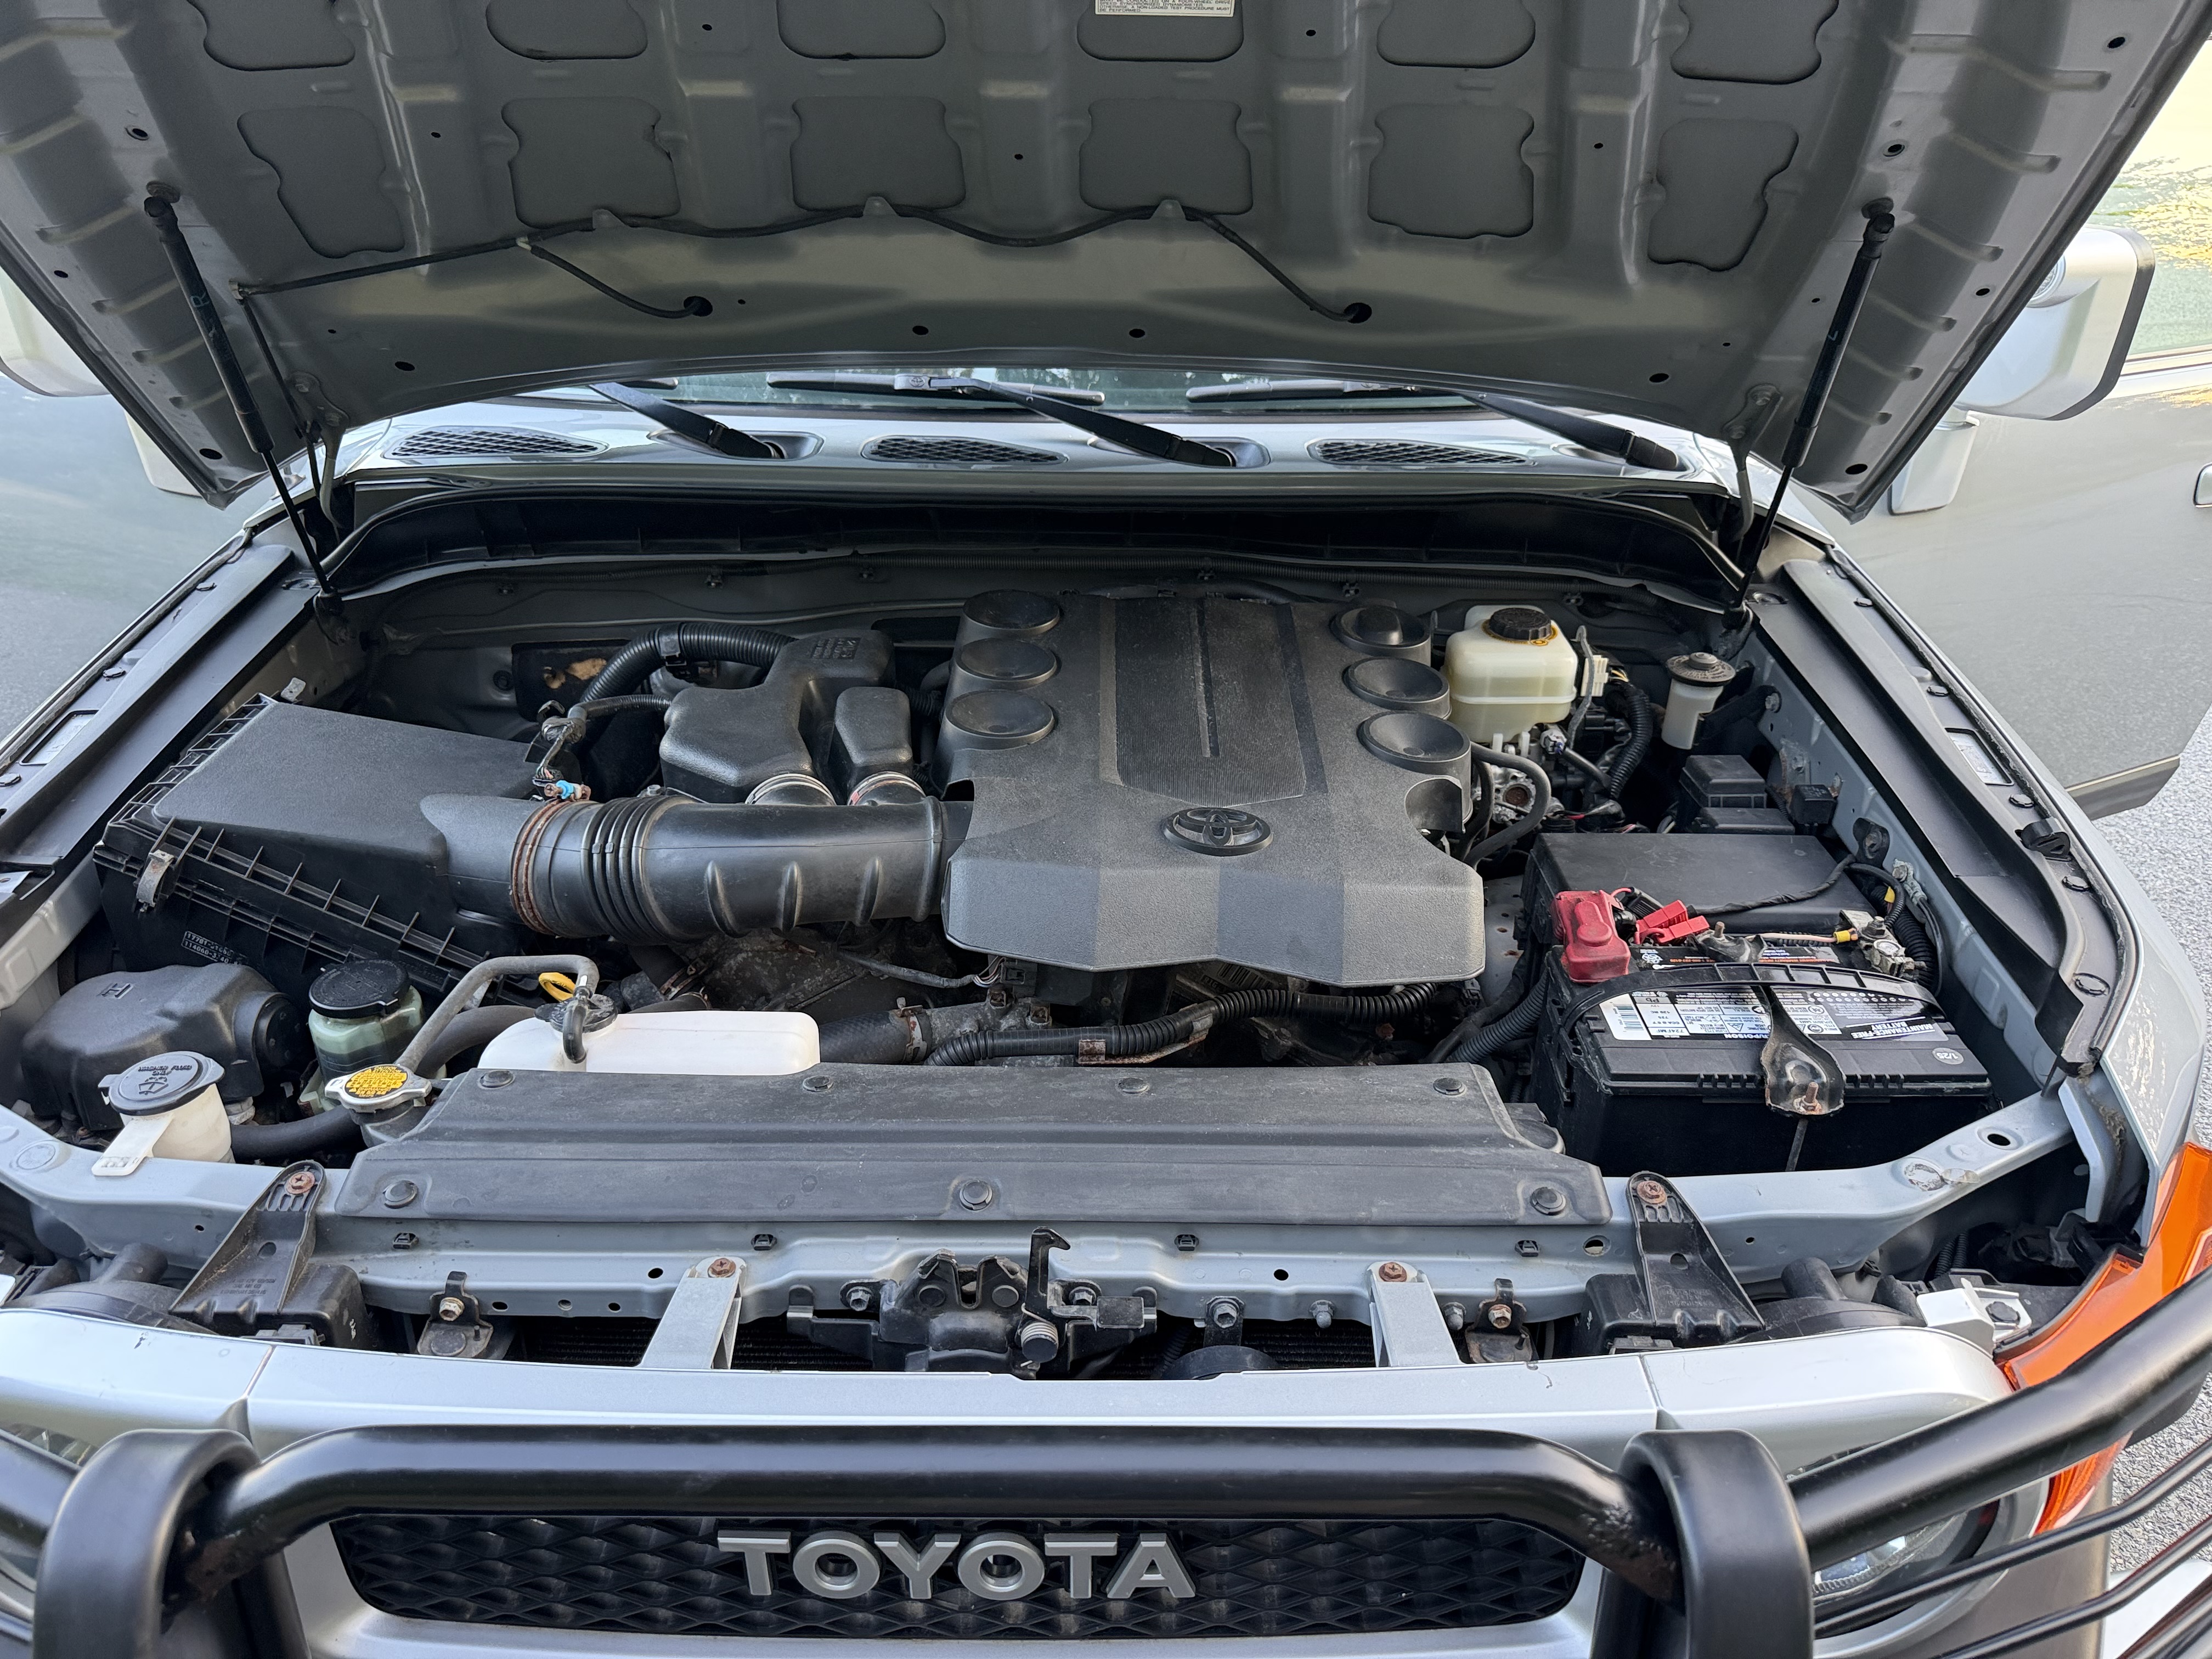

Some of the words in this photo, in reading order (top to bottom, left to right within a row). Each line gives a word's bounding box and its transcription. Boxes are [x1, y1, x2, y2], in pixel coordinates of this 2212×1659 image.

[1850, 1023, 1934, 1039] MAINTENANCE-FREE
[1870, 1021, 1908, 1031] BATTERY
[1936, 1052, 1959, 1060] 1/25
[717, 1530, 1196, 1600] TOYOTA
